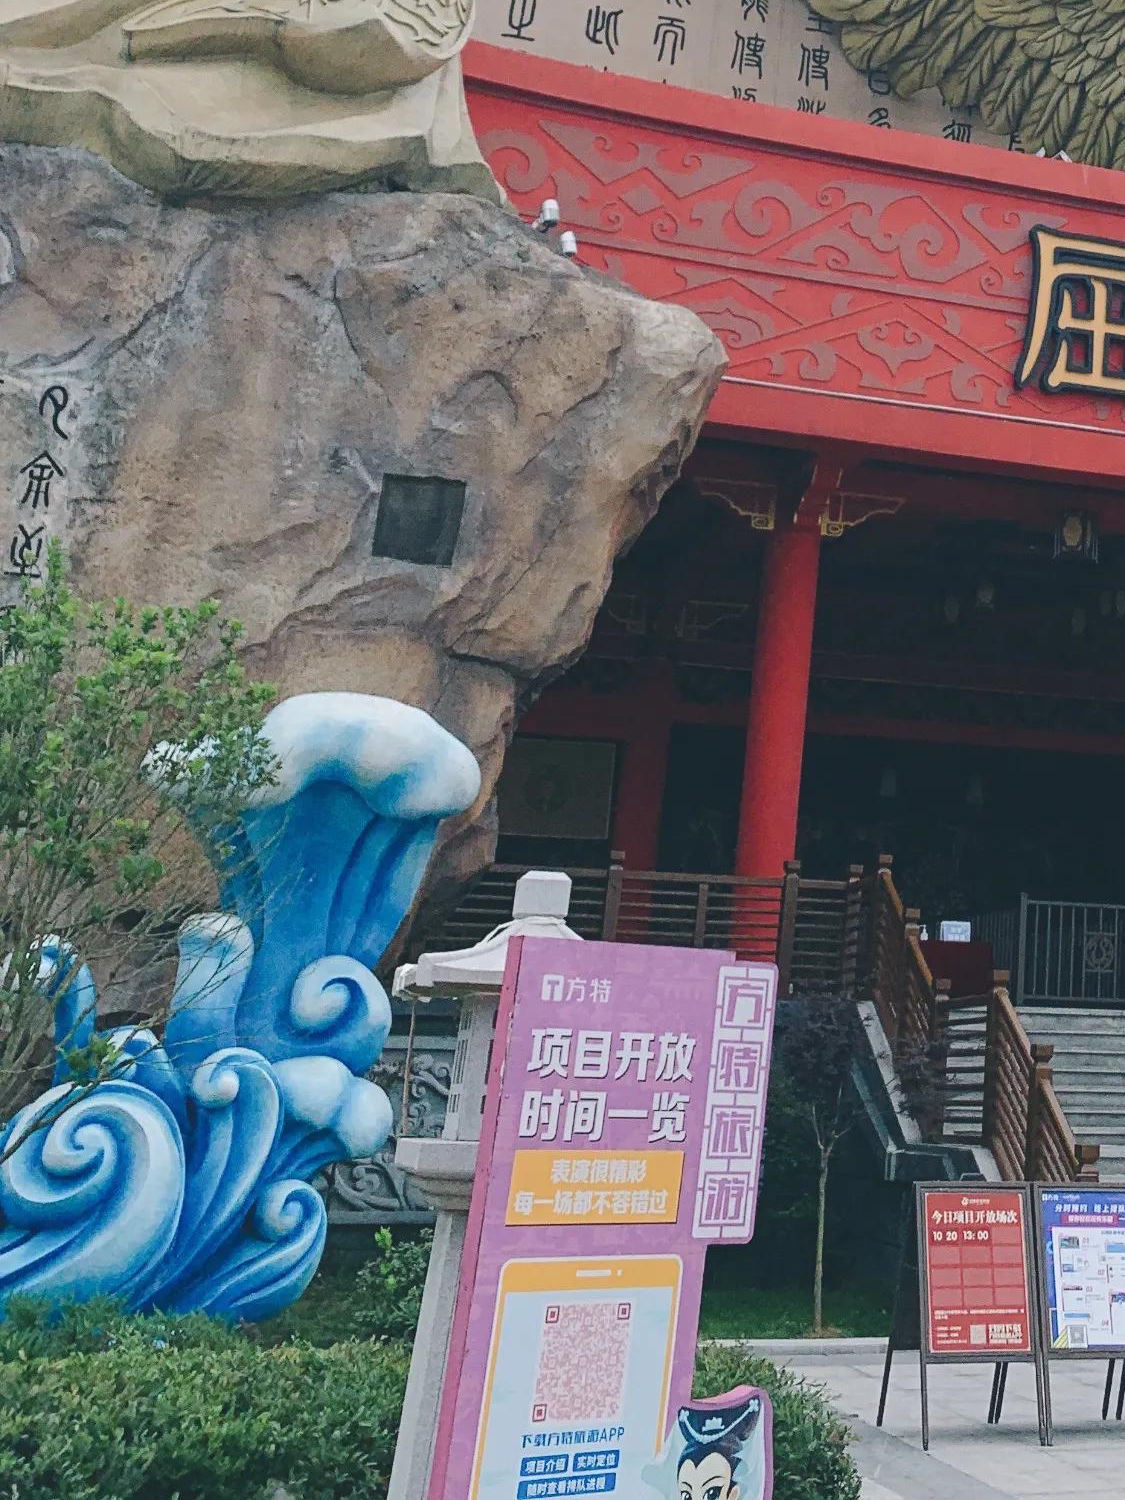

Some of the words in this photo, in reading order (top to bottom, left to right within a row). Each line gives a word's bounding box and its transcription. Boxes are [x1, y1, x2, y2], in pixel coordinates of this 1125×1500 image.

[565, 977, 612, 1003] 方特
[526, 1027, 697, 1083] 项目开放
[705, 983, 764, 1221] 方特旅游
[518, 1088, 691, 1143] 时间一览
[550, 1158, 647, 1184] 表演很精彩
[514, 1188, 669, 1216] 每一场都不容错过
[932, 1209, 1018, 1224] 今日项目开放场次
[521, 1426, 625, 1448] 下载方特旅游APP
[526, 1458, 567, 1474] 项目介绍
[576, 1453, 617, 1468] 实时定位
